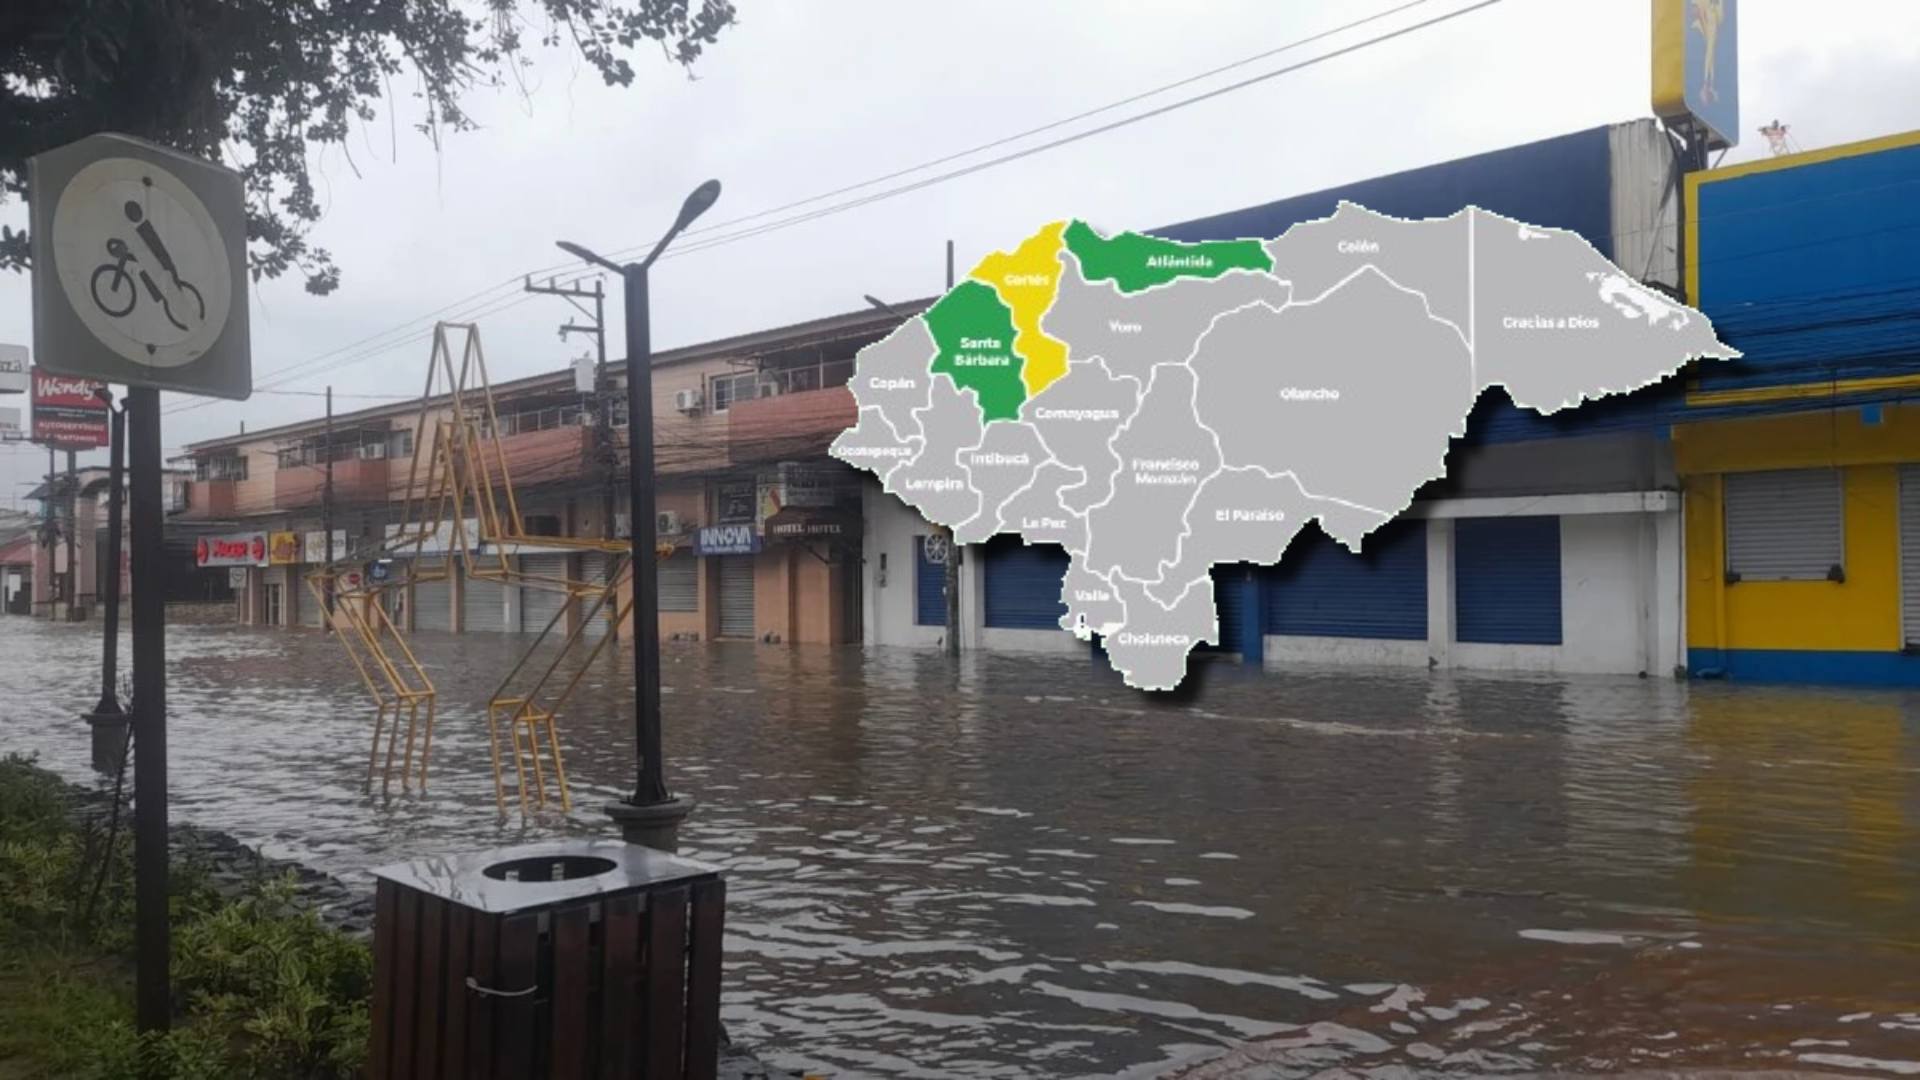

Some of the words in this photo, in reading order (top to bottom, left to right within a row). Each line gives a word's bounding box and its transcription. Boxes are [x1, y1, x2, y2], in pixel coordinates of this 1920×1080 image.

[772, 523, 804, 534] HOTEL
[807, 523, 841, 534] HOTEL
[700, 527, 751, 545] INNOVA
